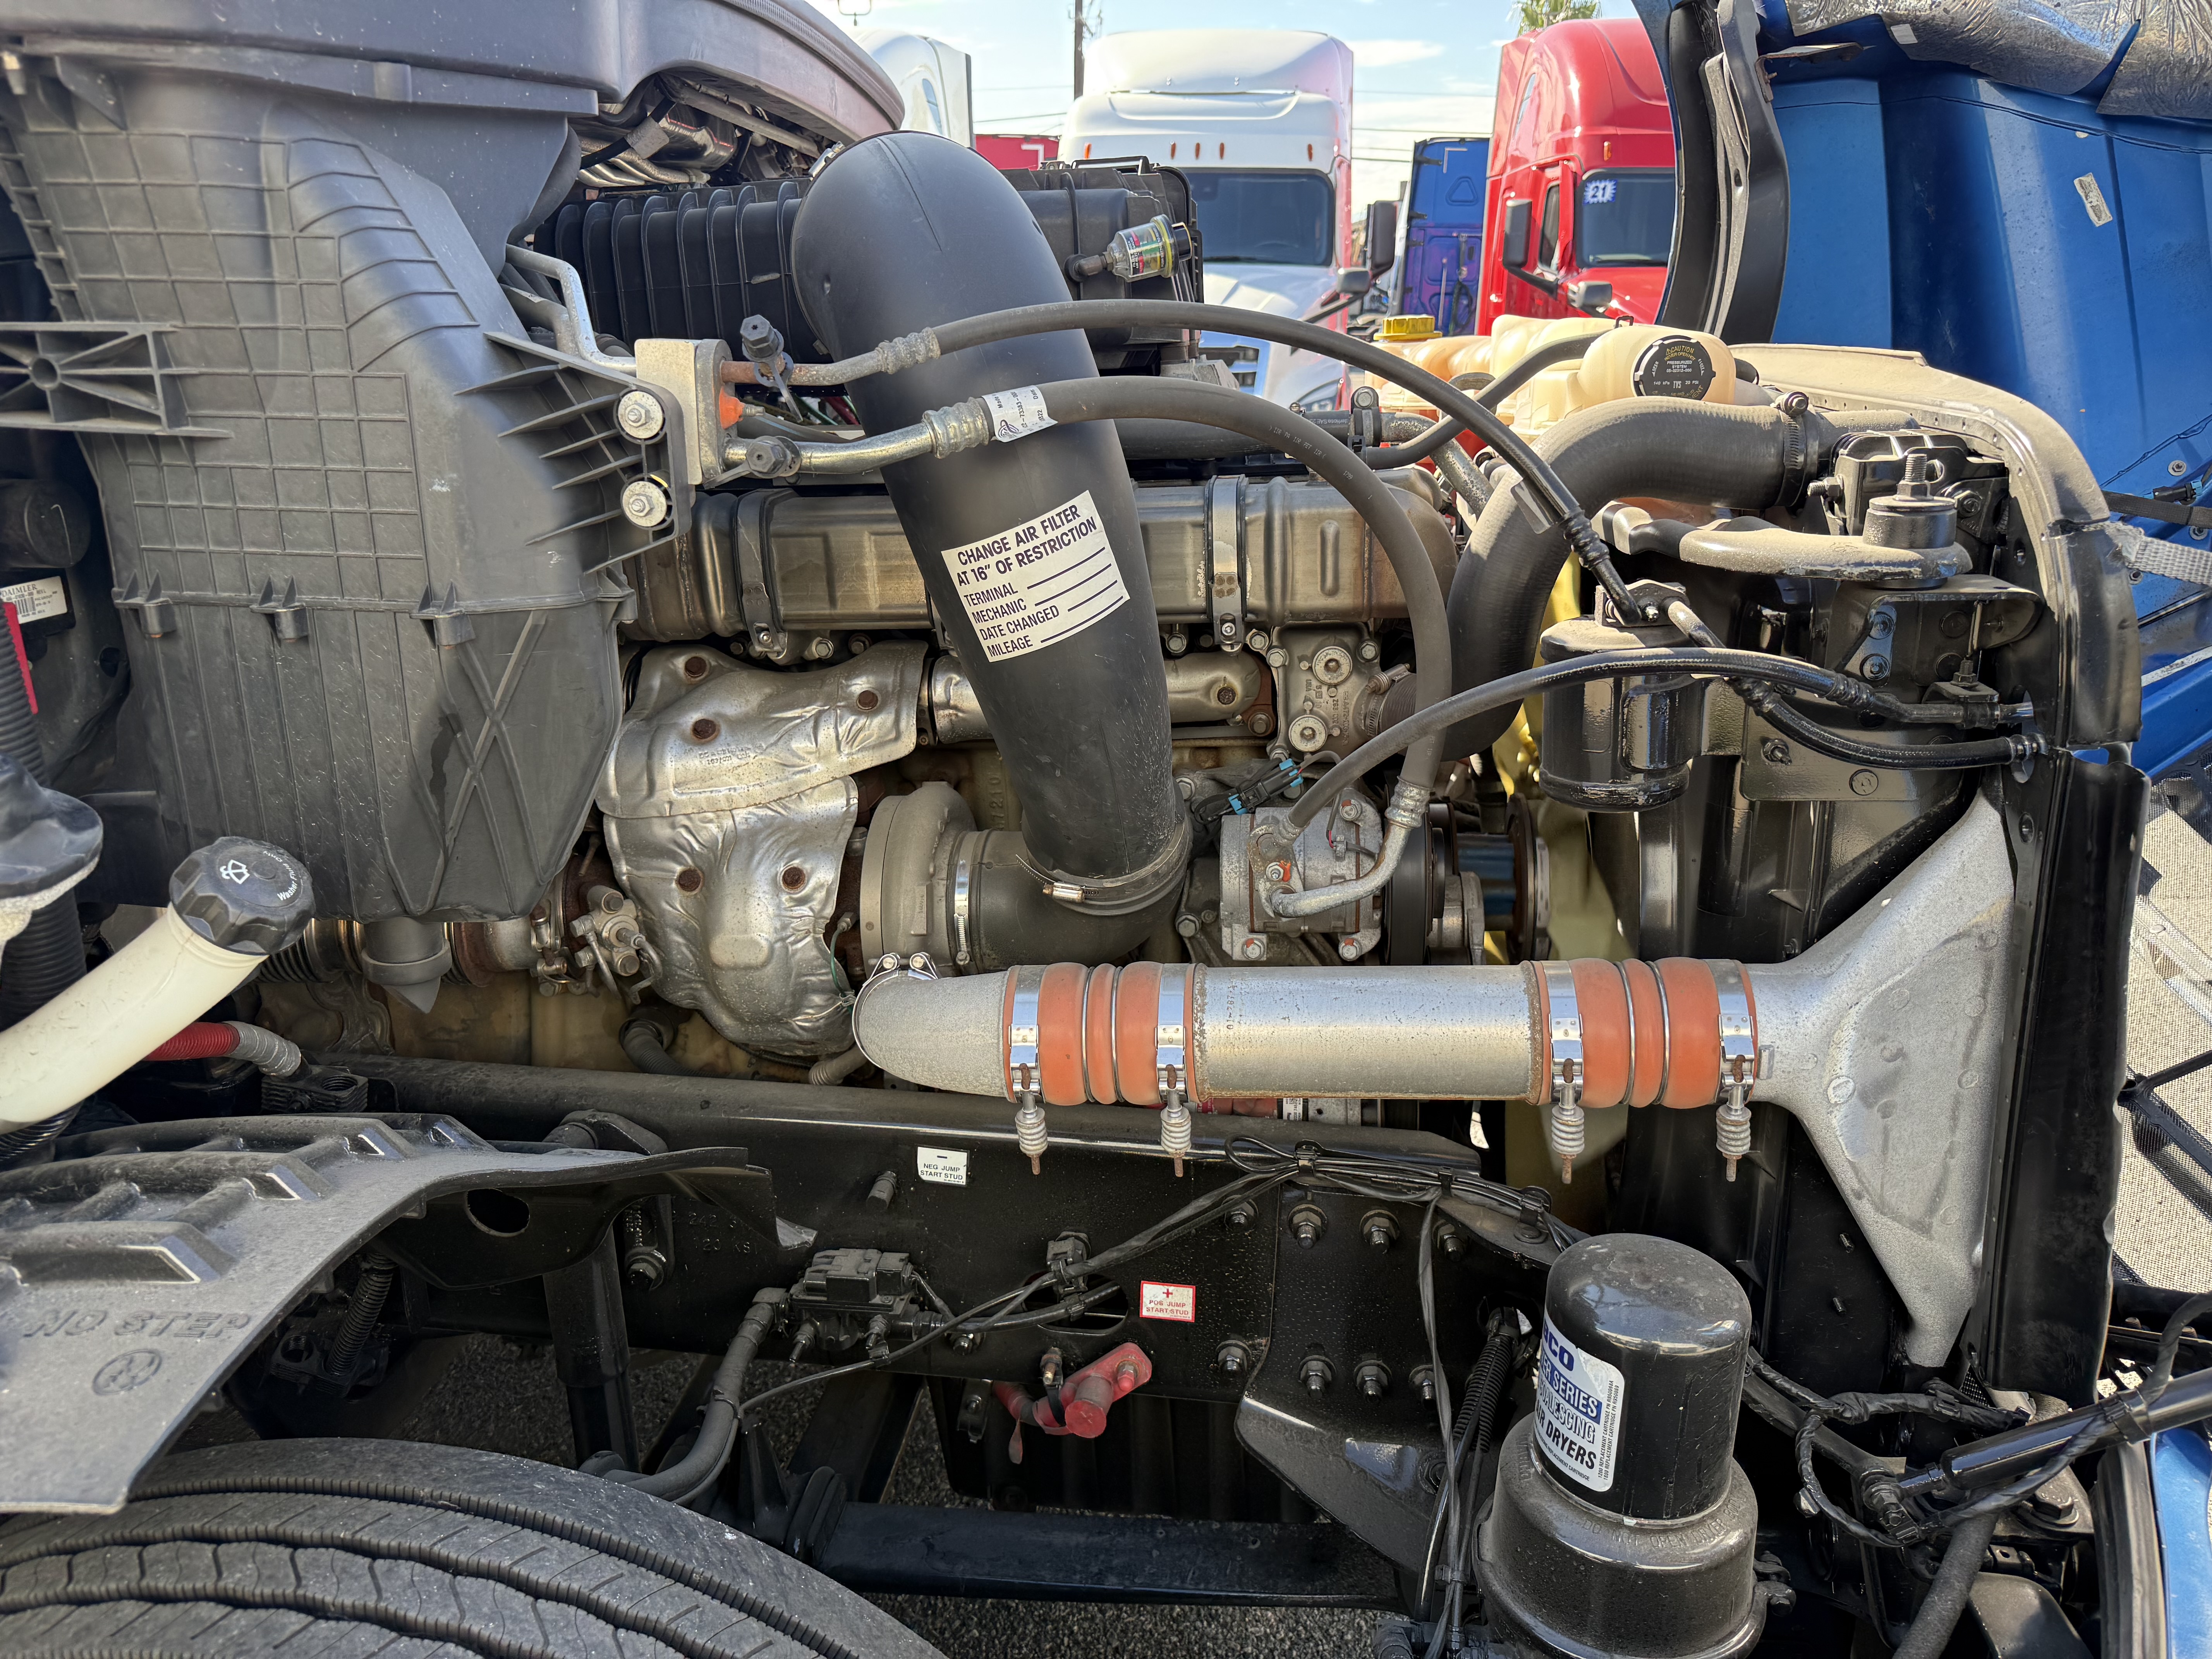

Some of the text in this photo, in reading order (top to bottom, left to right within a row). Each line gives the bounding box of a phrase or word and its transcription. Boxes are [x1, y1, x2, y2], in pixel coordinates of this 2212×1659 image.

[1591, 184, 1607, 198] 21
[1671, 345, 1694, 354] CAUTION
[995, 397, 1003, 408] Made
[958, 505, 1080, 565] CHANGE AIR FILTER
[957, 571, 969, 586] AT
[996, 557, 1013, 574] OF
[1015, 516, 1097, 568] RESTRICTION
[2, 584, 38, 597] DAIMLER
[964, 582, 1018, 607] TERMINAL
[972, 598, 1027, 624] MECHANIC
[979, 605, 1060, 641] DATE CHANGED
[987, 635, 1033, 657] MILEAGE
[283, 863, 298, 880] Fluid
[277, 882, 298, 901] Washer
[115, 1310, 250, 1338] STEP
[1553, 1370, 1598, 1418] SERIES
[1546, 1419, 1597, 1470] DRYERS
[1599, 1435, 1607, 1467] REPLACEMENT
[1605, 1437, 1613, 1469] REPLACEMENT
[1569, 1465, 1590, 1482] CARTRIDGE
[1650, 1534, 1687, 1548] OPEN
